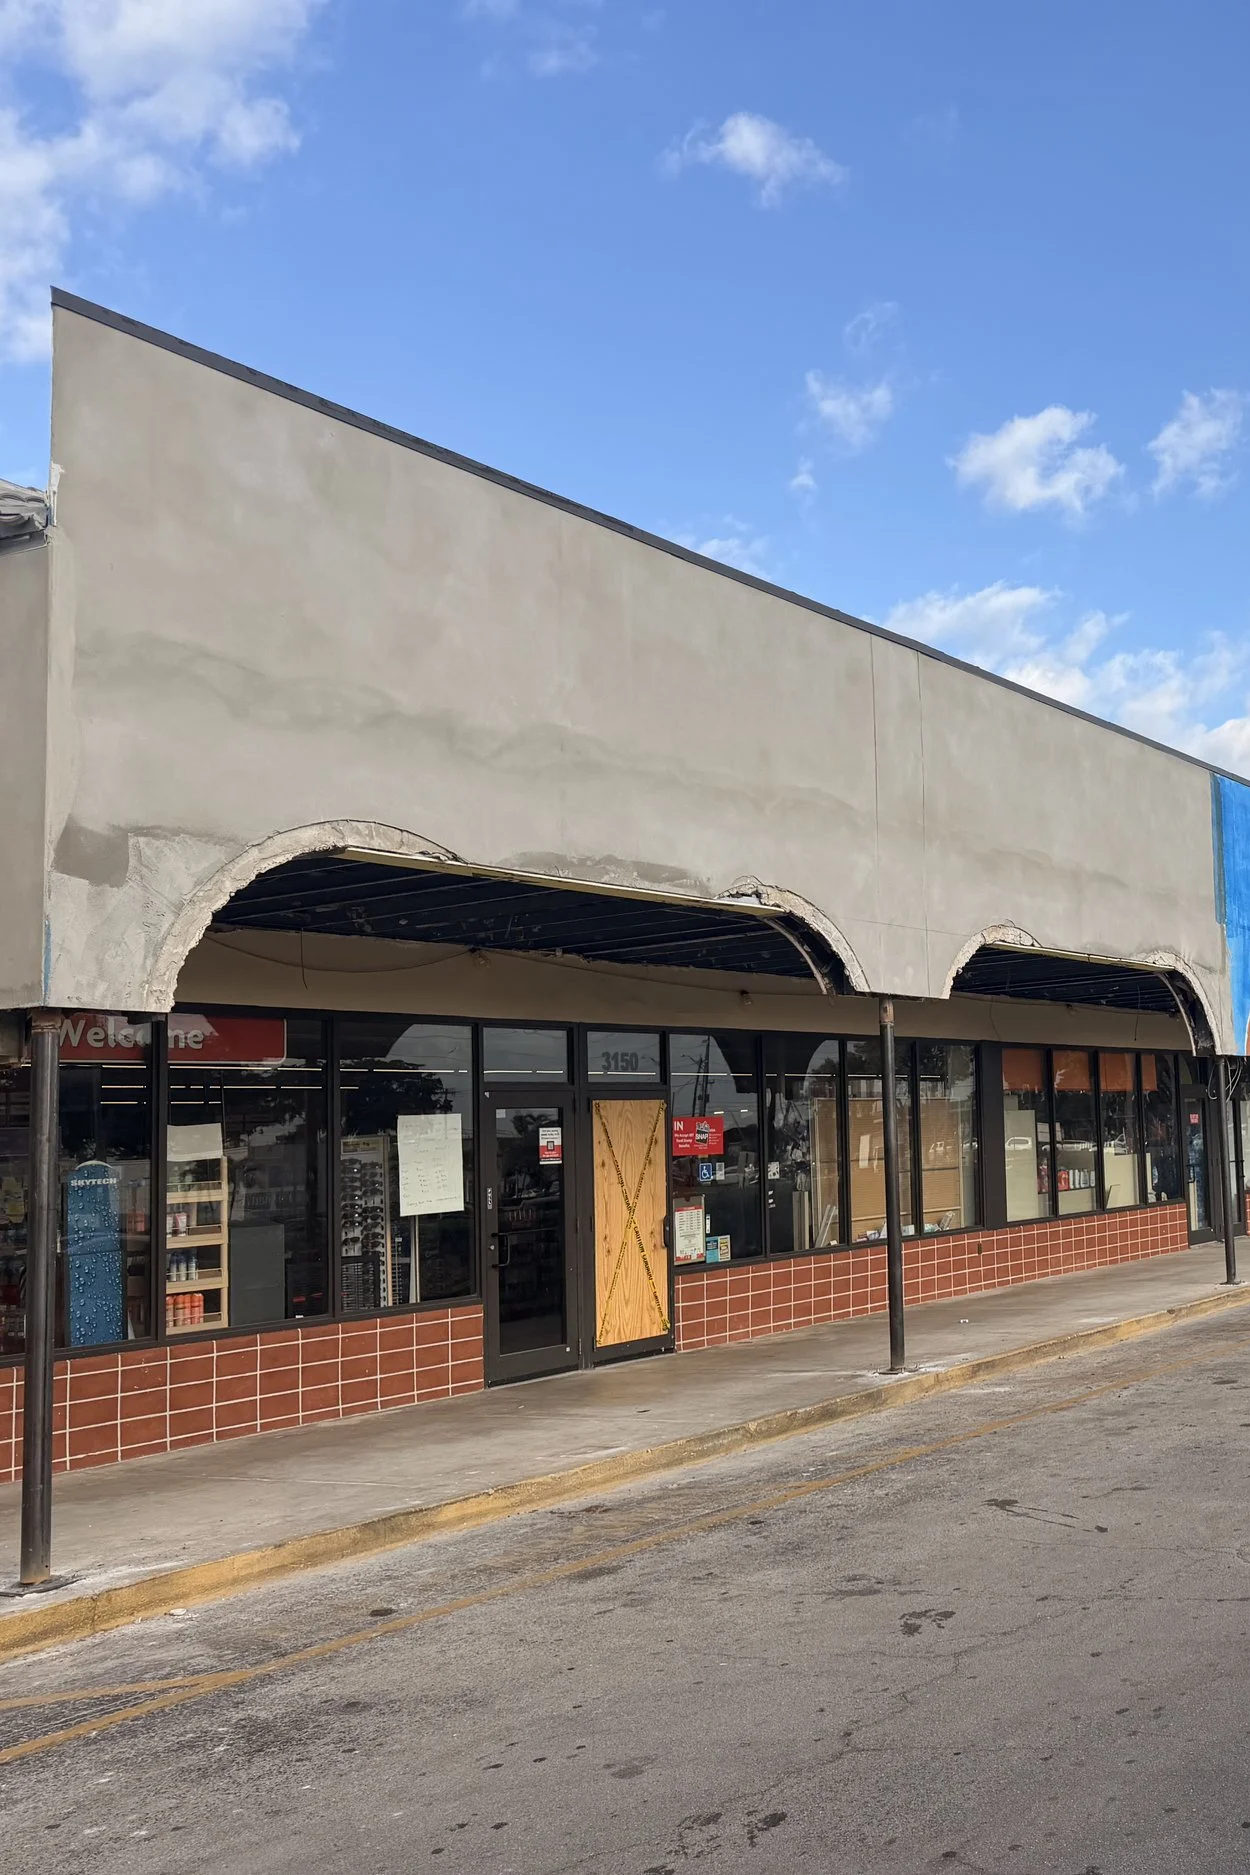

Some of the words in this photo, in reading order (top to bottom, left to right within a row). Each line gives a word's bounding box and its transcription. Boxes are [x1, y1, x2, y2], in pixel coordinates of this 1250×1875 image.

[601, 1051, 639, 1071] 3150
[674, 1121, 683, 1131] IN
[71, 1178, 117, 1187] SKYTECH
